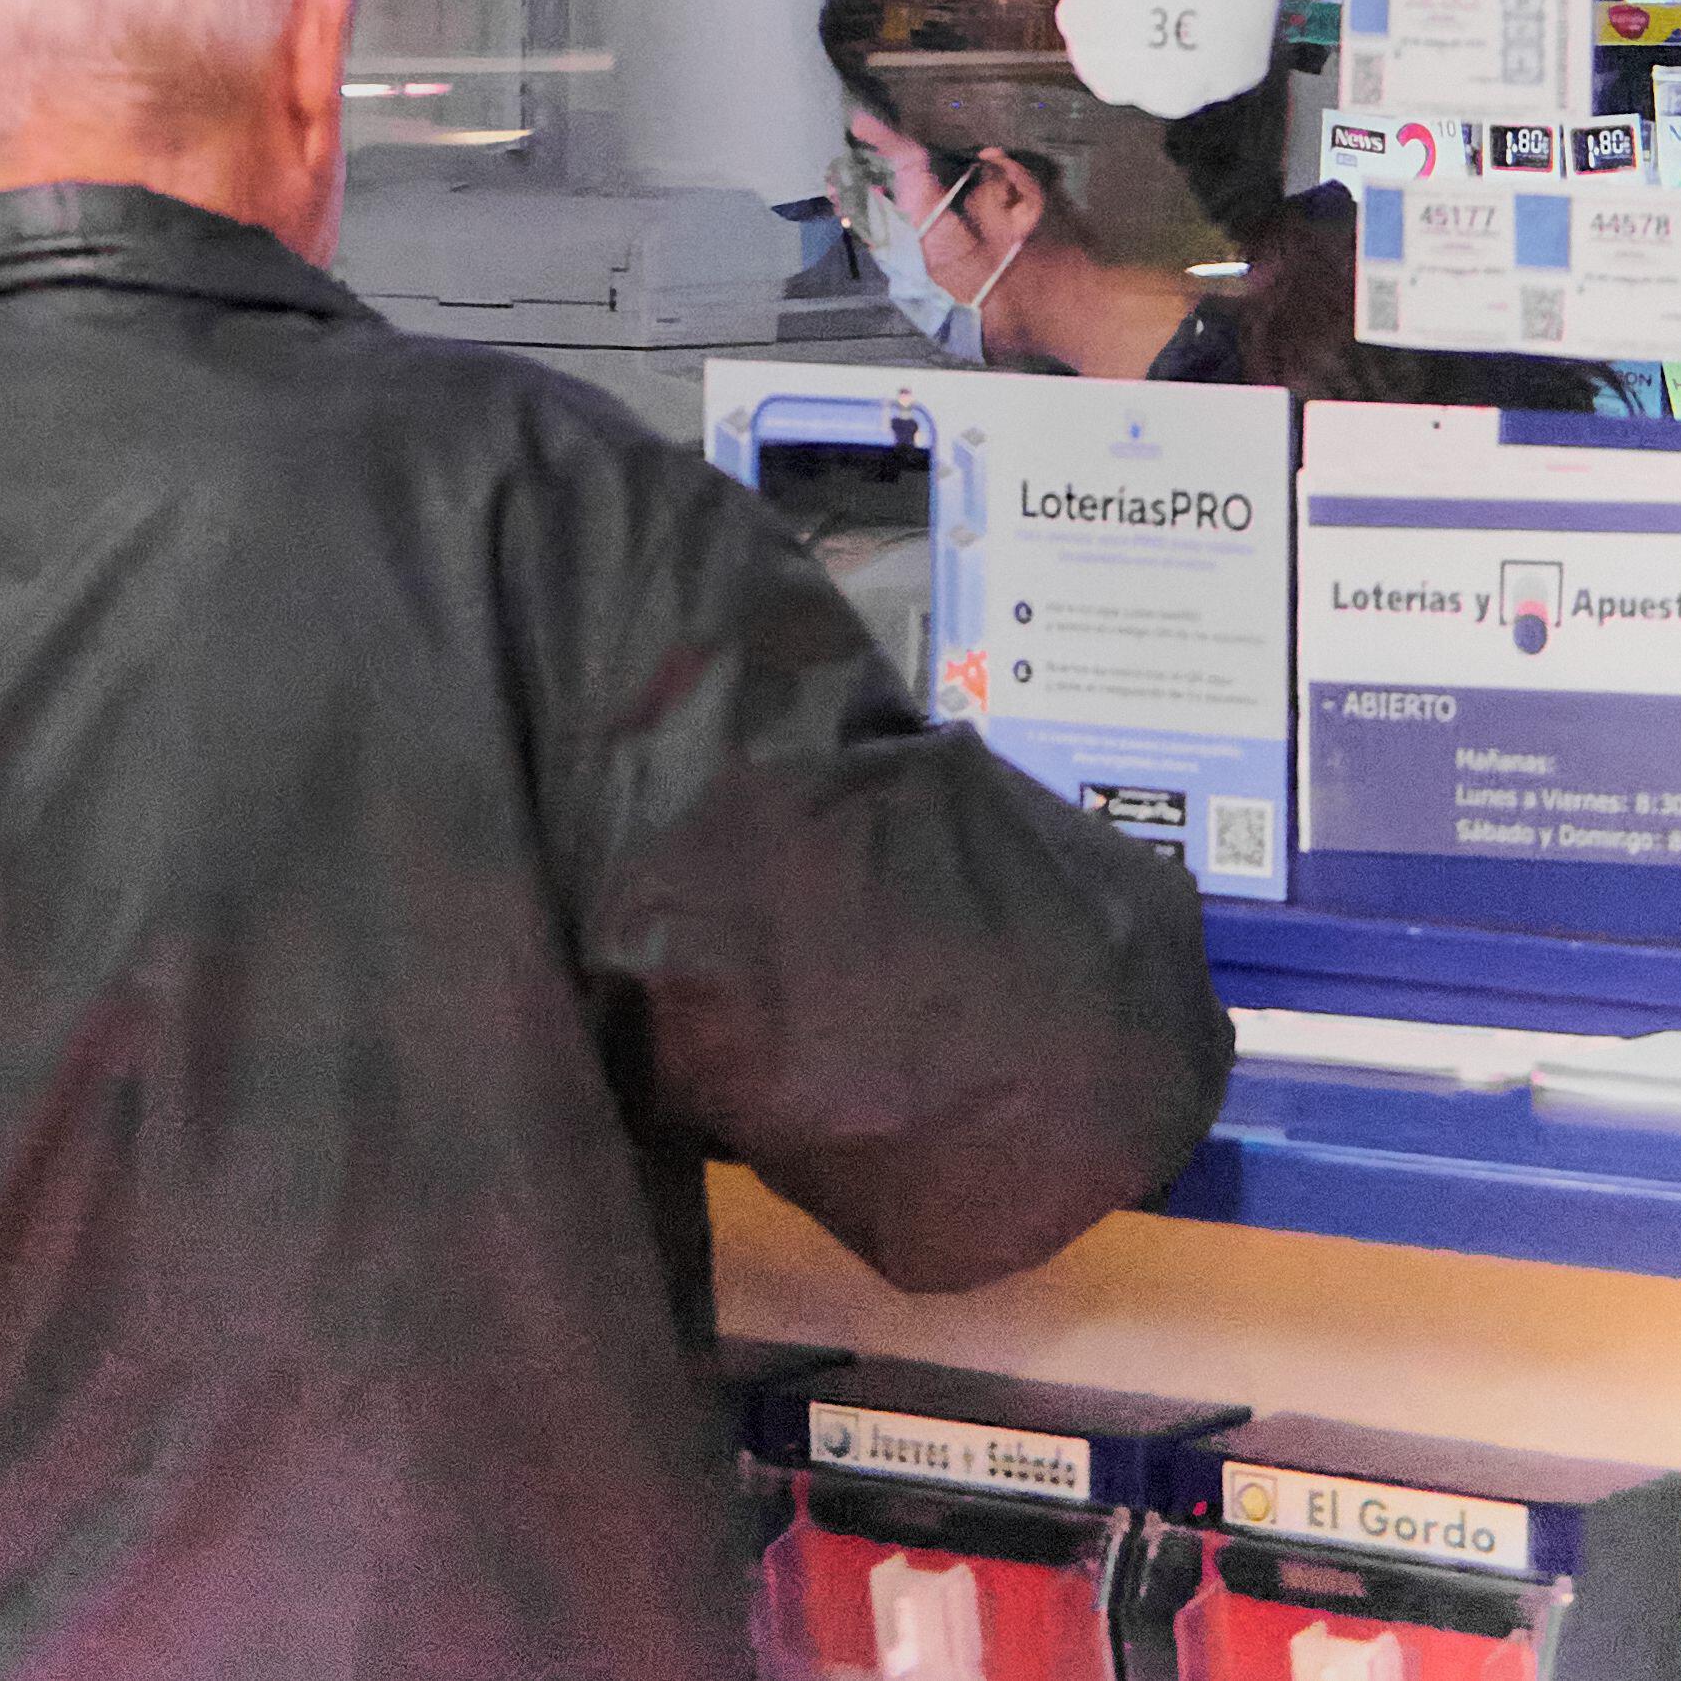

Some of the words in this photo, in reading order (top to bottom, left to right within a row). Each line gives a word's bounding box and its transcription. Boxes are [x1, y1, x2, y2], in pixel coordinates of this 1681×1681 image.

[1334, 128, 1385, 152] News
[1475, 590, 1490, 622] y
[1344, 692, 1457, 722] ABIERTO
[1455, 784, 1517, 807] Lunes
[1524, 790, 1536, 809] a
[1539, 827, 1553, 849] y
[1307, 1488, 1338, 1529] El
[1358, 1497, 1496, 1553] Gordo
